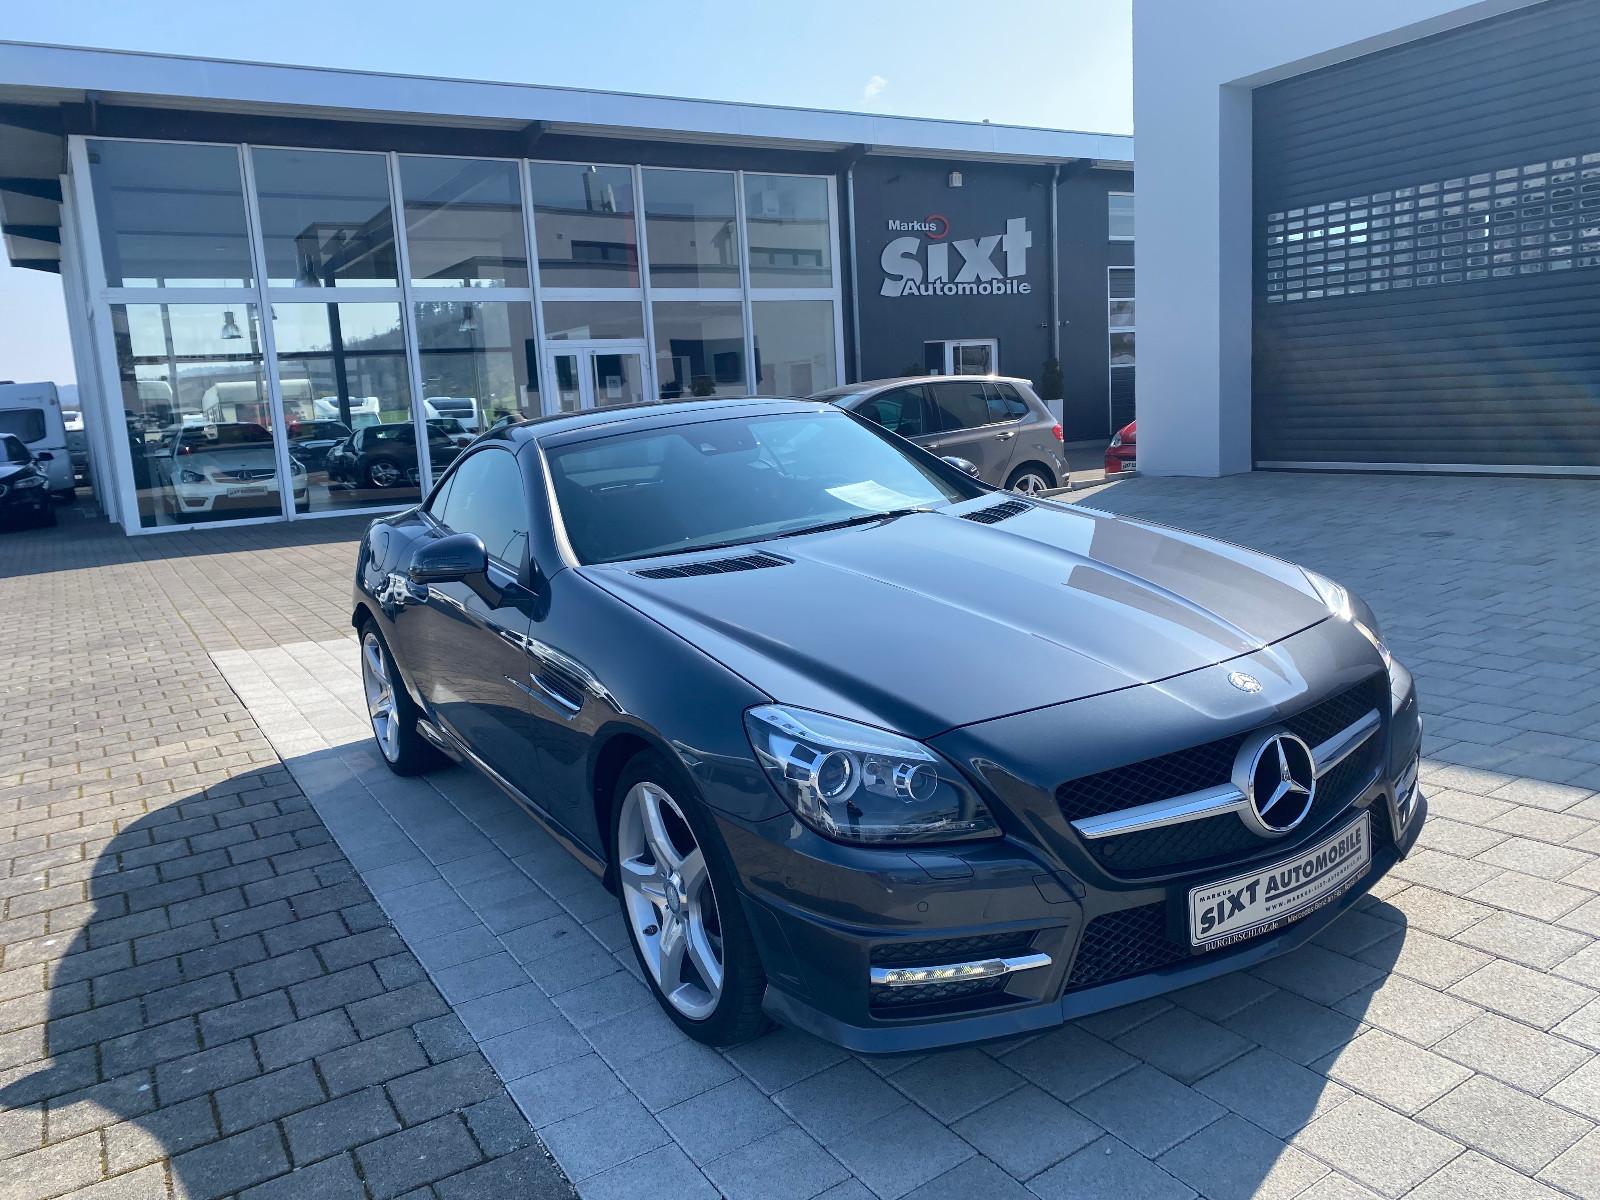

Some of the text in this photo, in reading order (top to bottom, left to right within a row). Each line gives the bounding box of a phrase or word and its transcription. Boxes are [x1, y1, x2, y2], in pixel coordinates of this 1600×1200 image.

[888, 219, 937, 231] Markus
[902, 275, 1032, 296] Automobile
[1200, 827, 1362, 935] SIXT AUTOMOBILE
[1199, 888, 1232, 903] MARKUS
